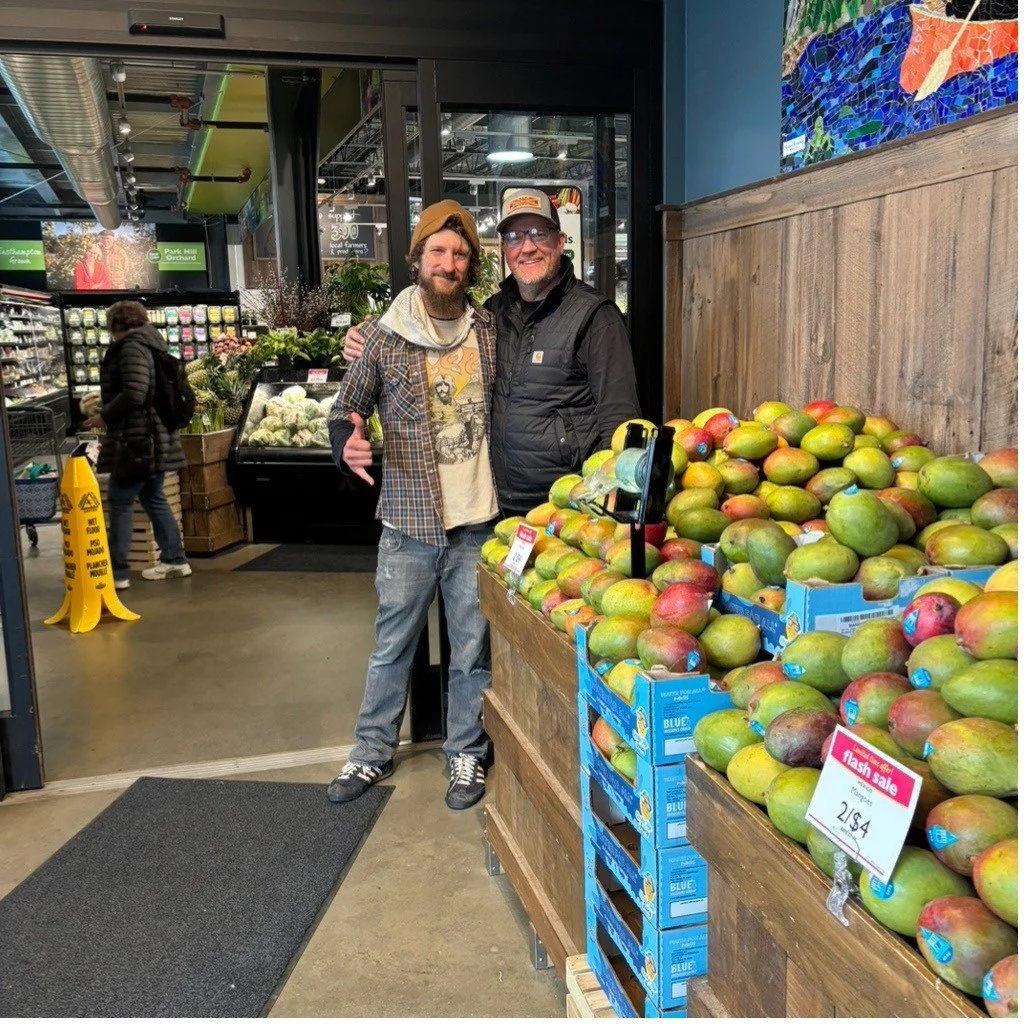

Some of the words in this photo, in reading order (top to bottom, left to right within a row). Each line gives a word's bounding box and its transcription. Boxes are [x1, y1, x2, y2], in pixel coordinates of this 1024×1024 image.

[86, 526, 100, 534] FLOOR
[90, 539, 100, 547] PISO
[86, 546, 104, 556] MOJADO
[86, 560, 108, 570] PLANCHER
[663, 716, 687, 729] BLUE
[842, 749, 871, 781] flash
[872, 772, 898, 797] sale
[836, 801, 871, 839] 2/$4
[669, 881, 692, 892] BLUE
[671, 962, 693, 974] BLUE
